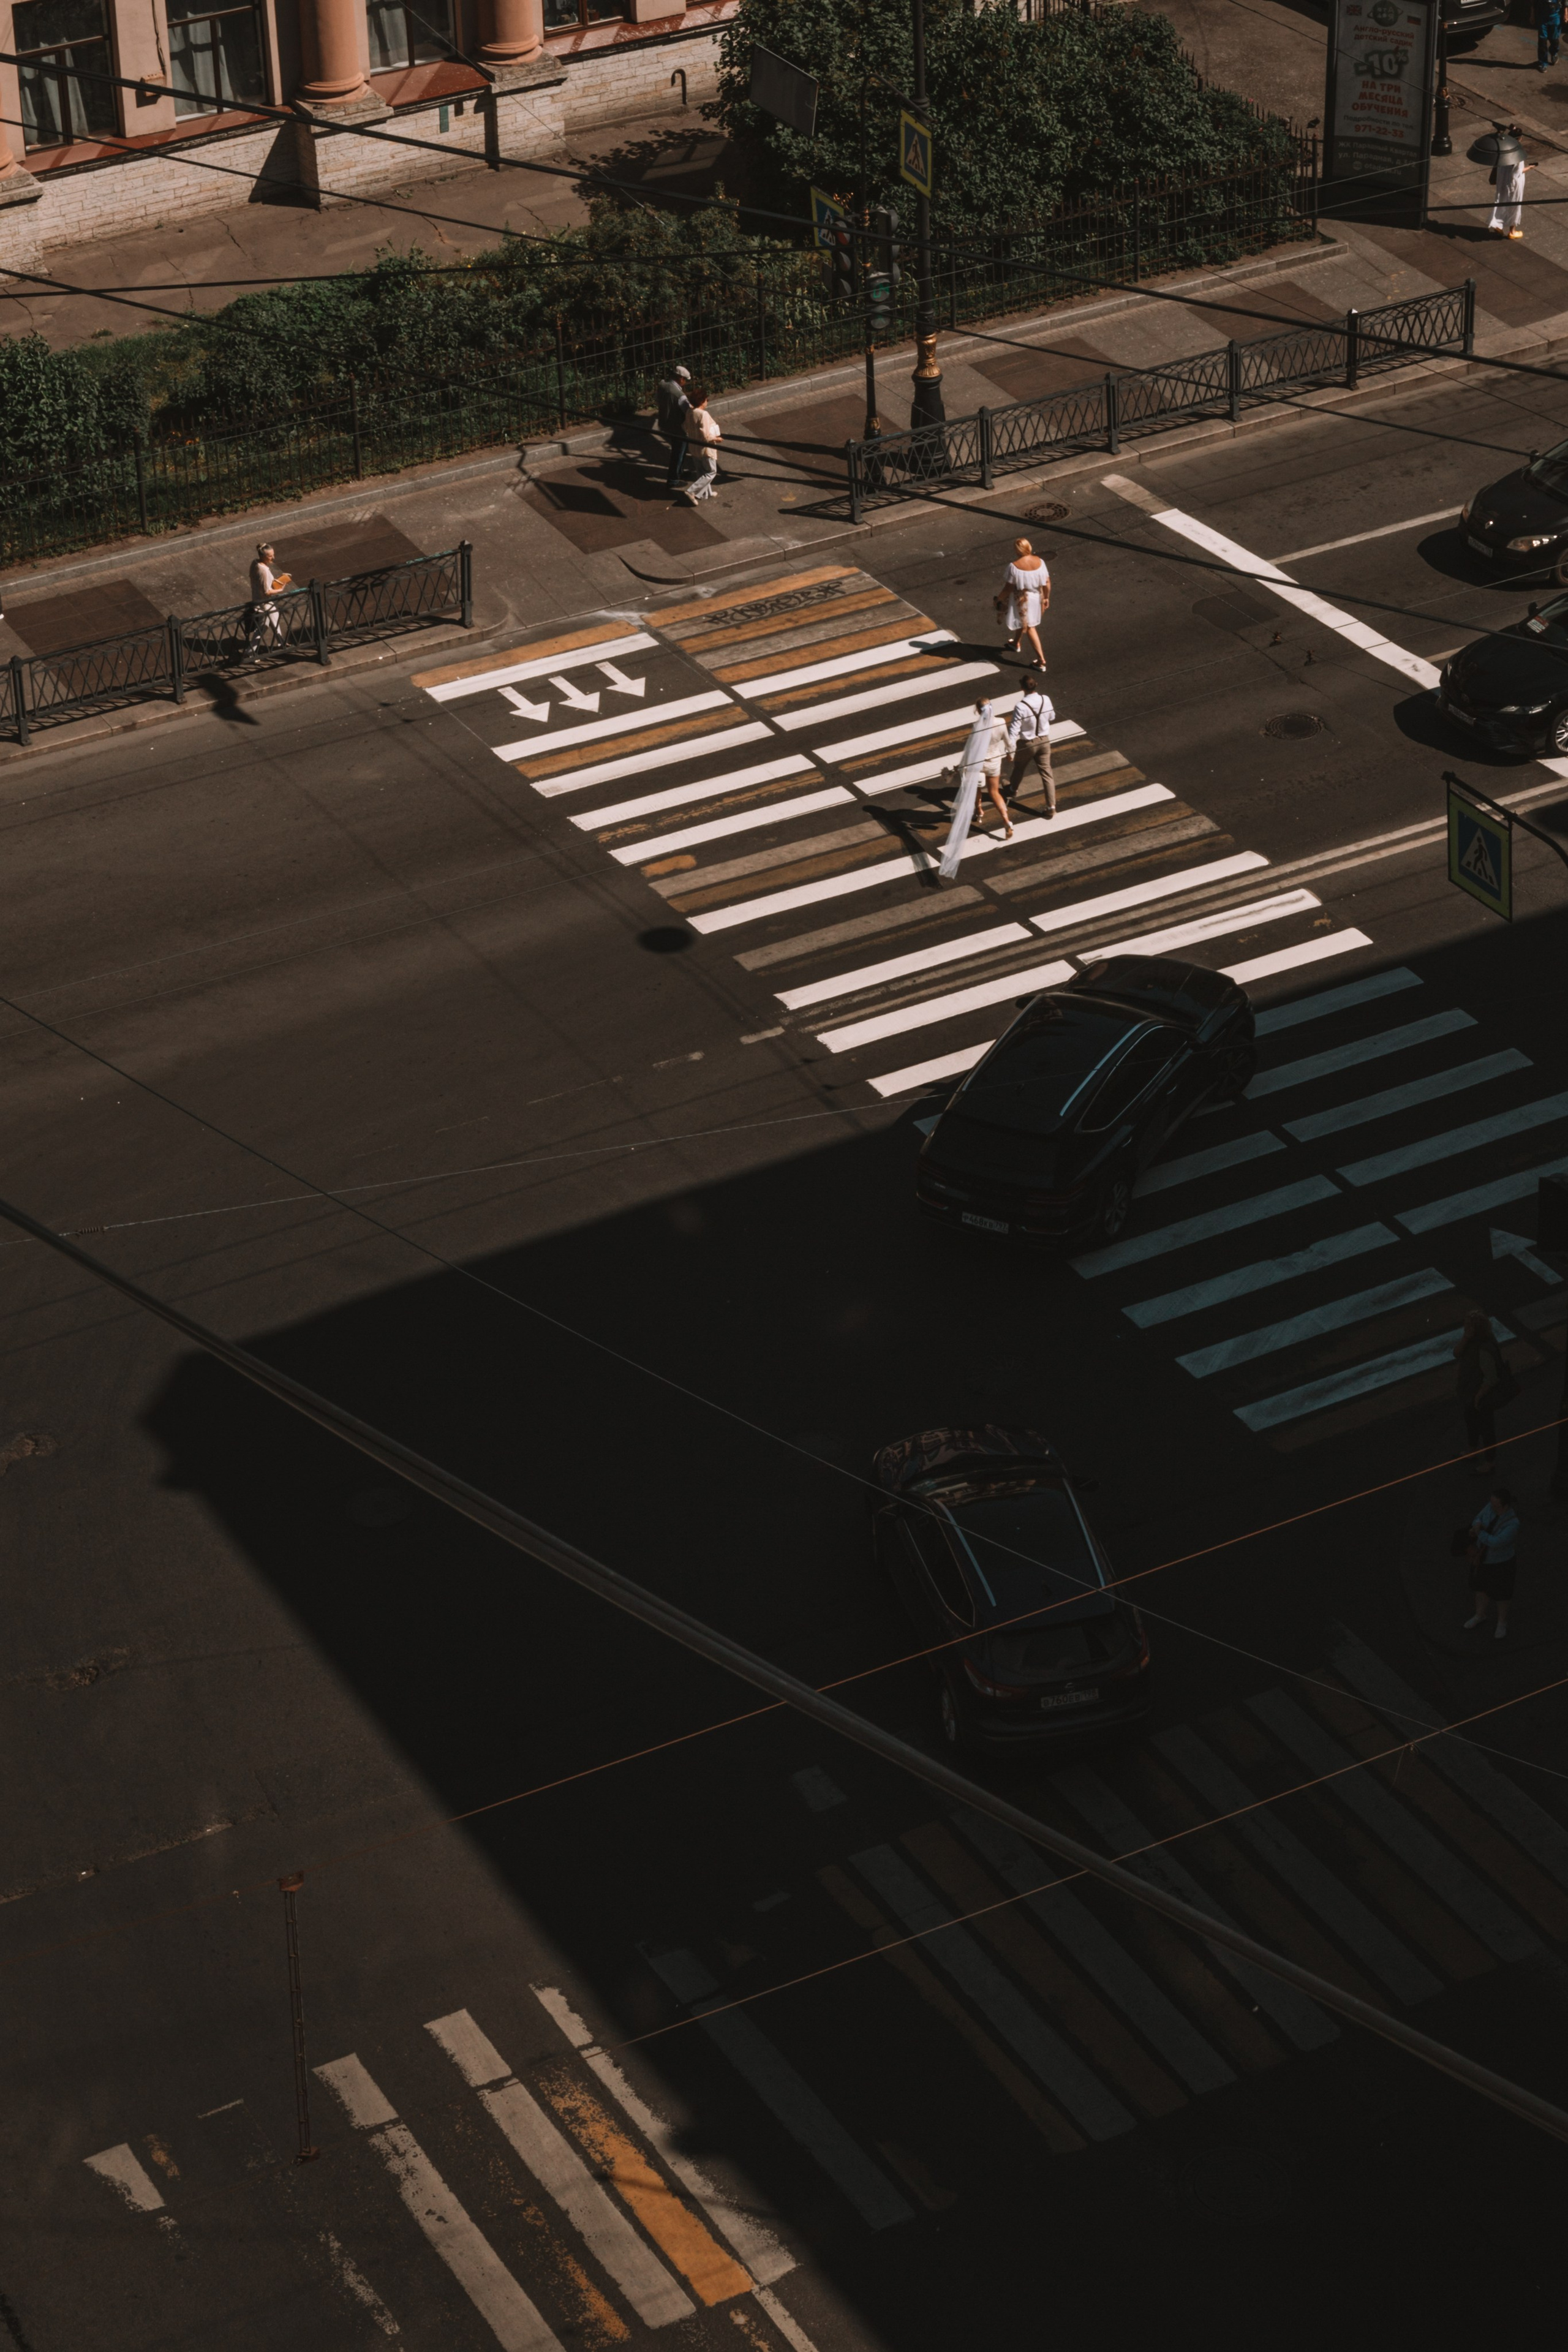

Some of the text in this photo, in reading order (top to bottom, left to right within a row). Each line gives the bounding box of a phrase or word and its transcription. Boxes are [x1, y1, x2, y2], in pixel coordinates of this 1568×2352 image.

[1354, 24, 1414, 39] Англо-русский
[1354, 34, 1413, 47] детский садик
[1362, 81, 1401, 93] НА ТРИ
[1359, 92, 1403, 105] МЕСЯЦА
[1352, 102, 1408, 118] ОБУЧЕНИЯ
[1344, 115, 1390, 126] Подробности
[1354, 124, 1404, 138] 971-22-33
[1390, 147, 1417, 158] Квартал
